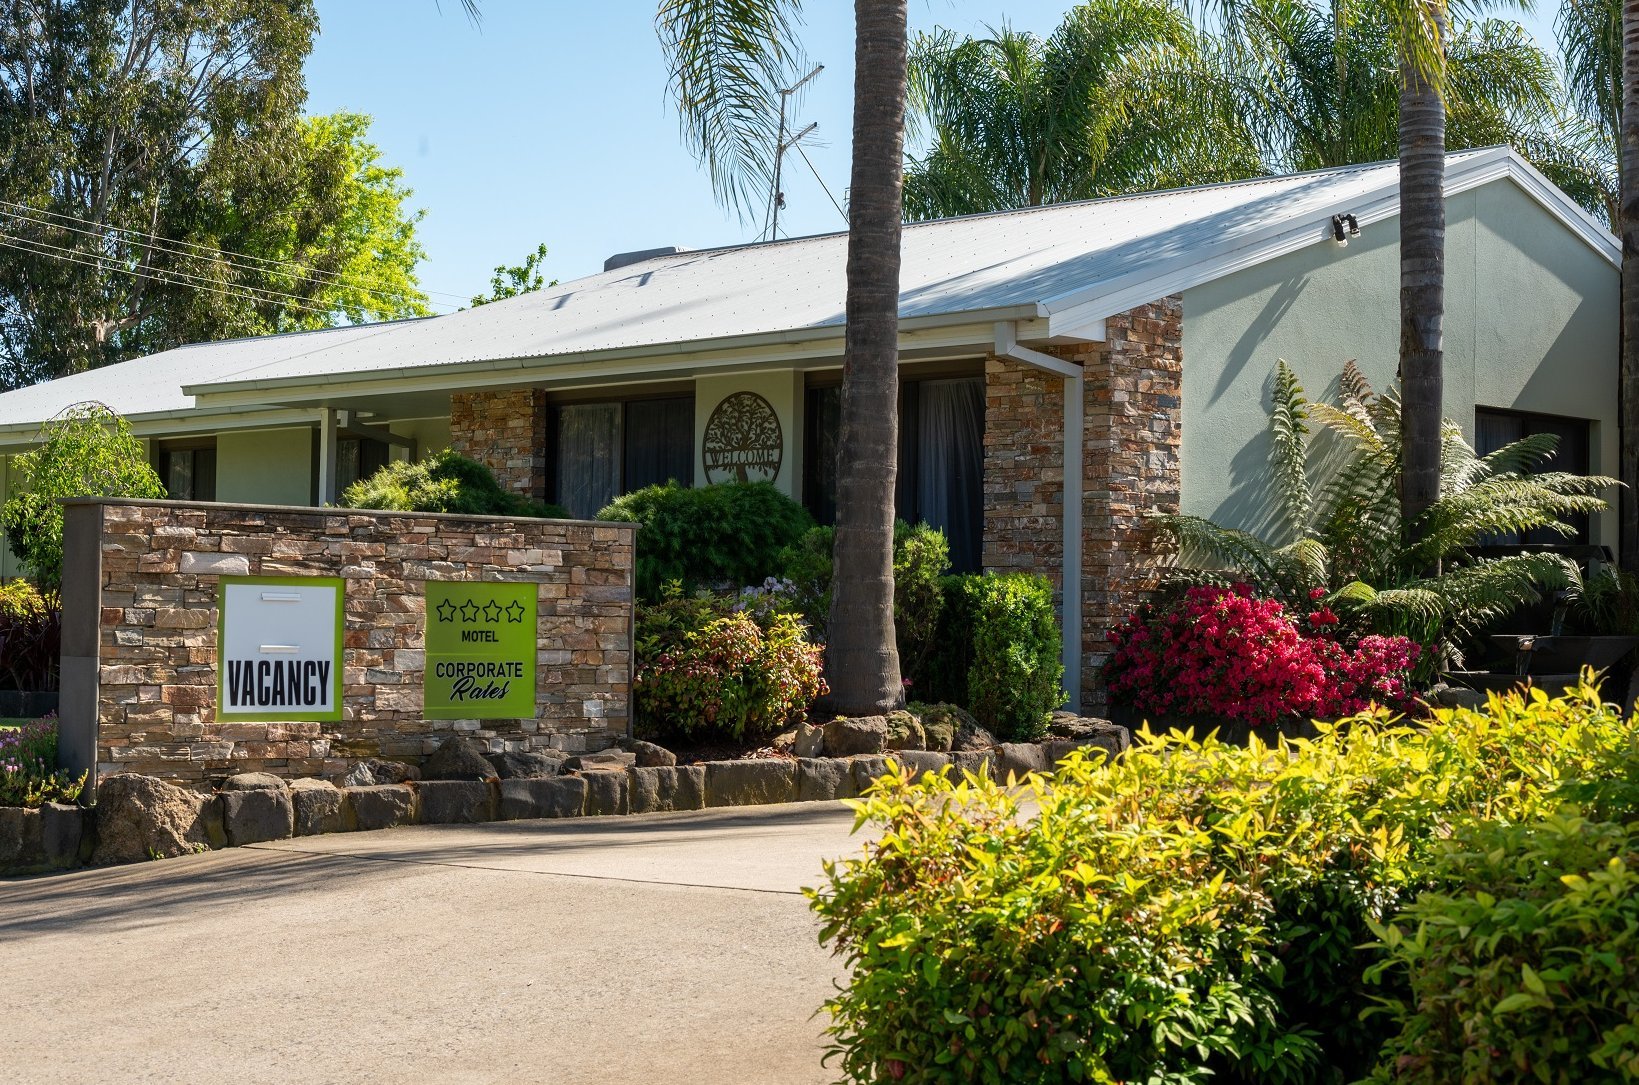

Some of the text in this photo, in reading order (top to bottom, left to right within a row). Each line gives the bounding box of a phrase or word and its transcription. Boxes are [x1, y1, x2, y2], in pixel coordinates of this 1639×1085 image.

[710, 449, 774, 465] WELCOME
[461, 630, 499, 643] MOTEL
[435, 661, 523, 678] CORPORATE
[228, 660, 331, 706] VACANCY
[449, 675, 511, 702] Rates
